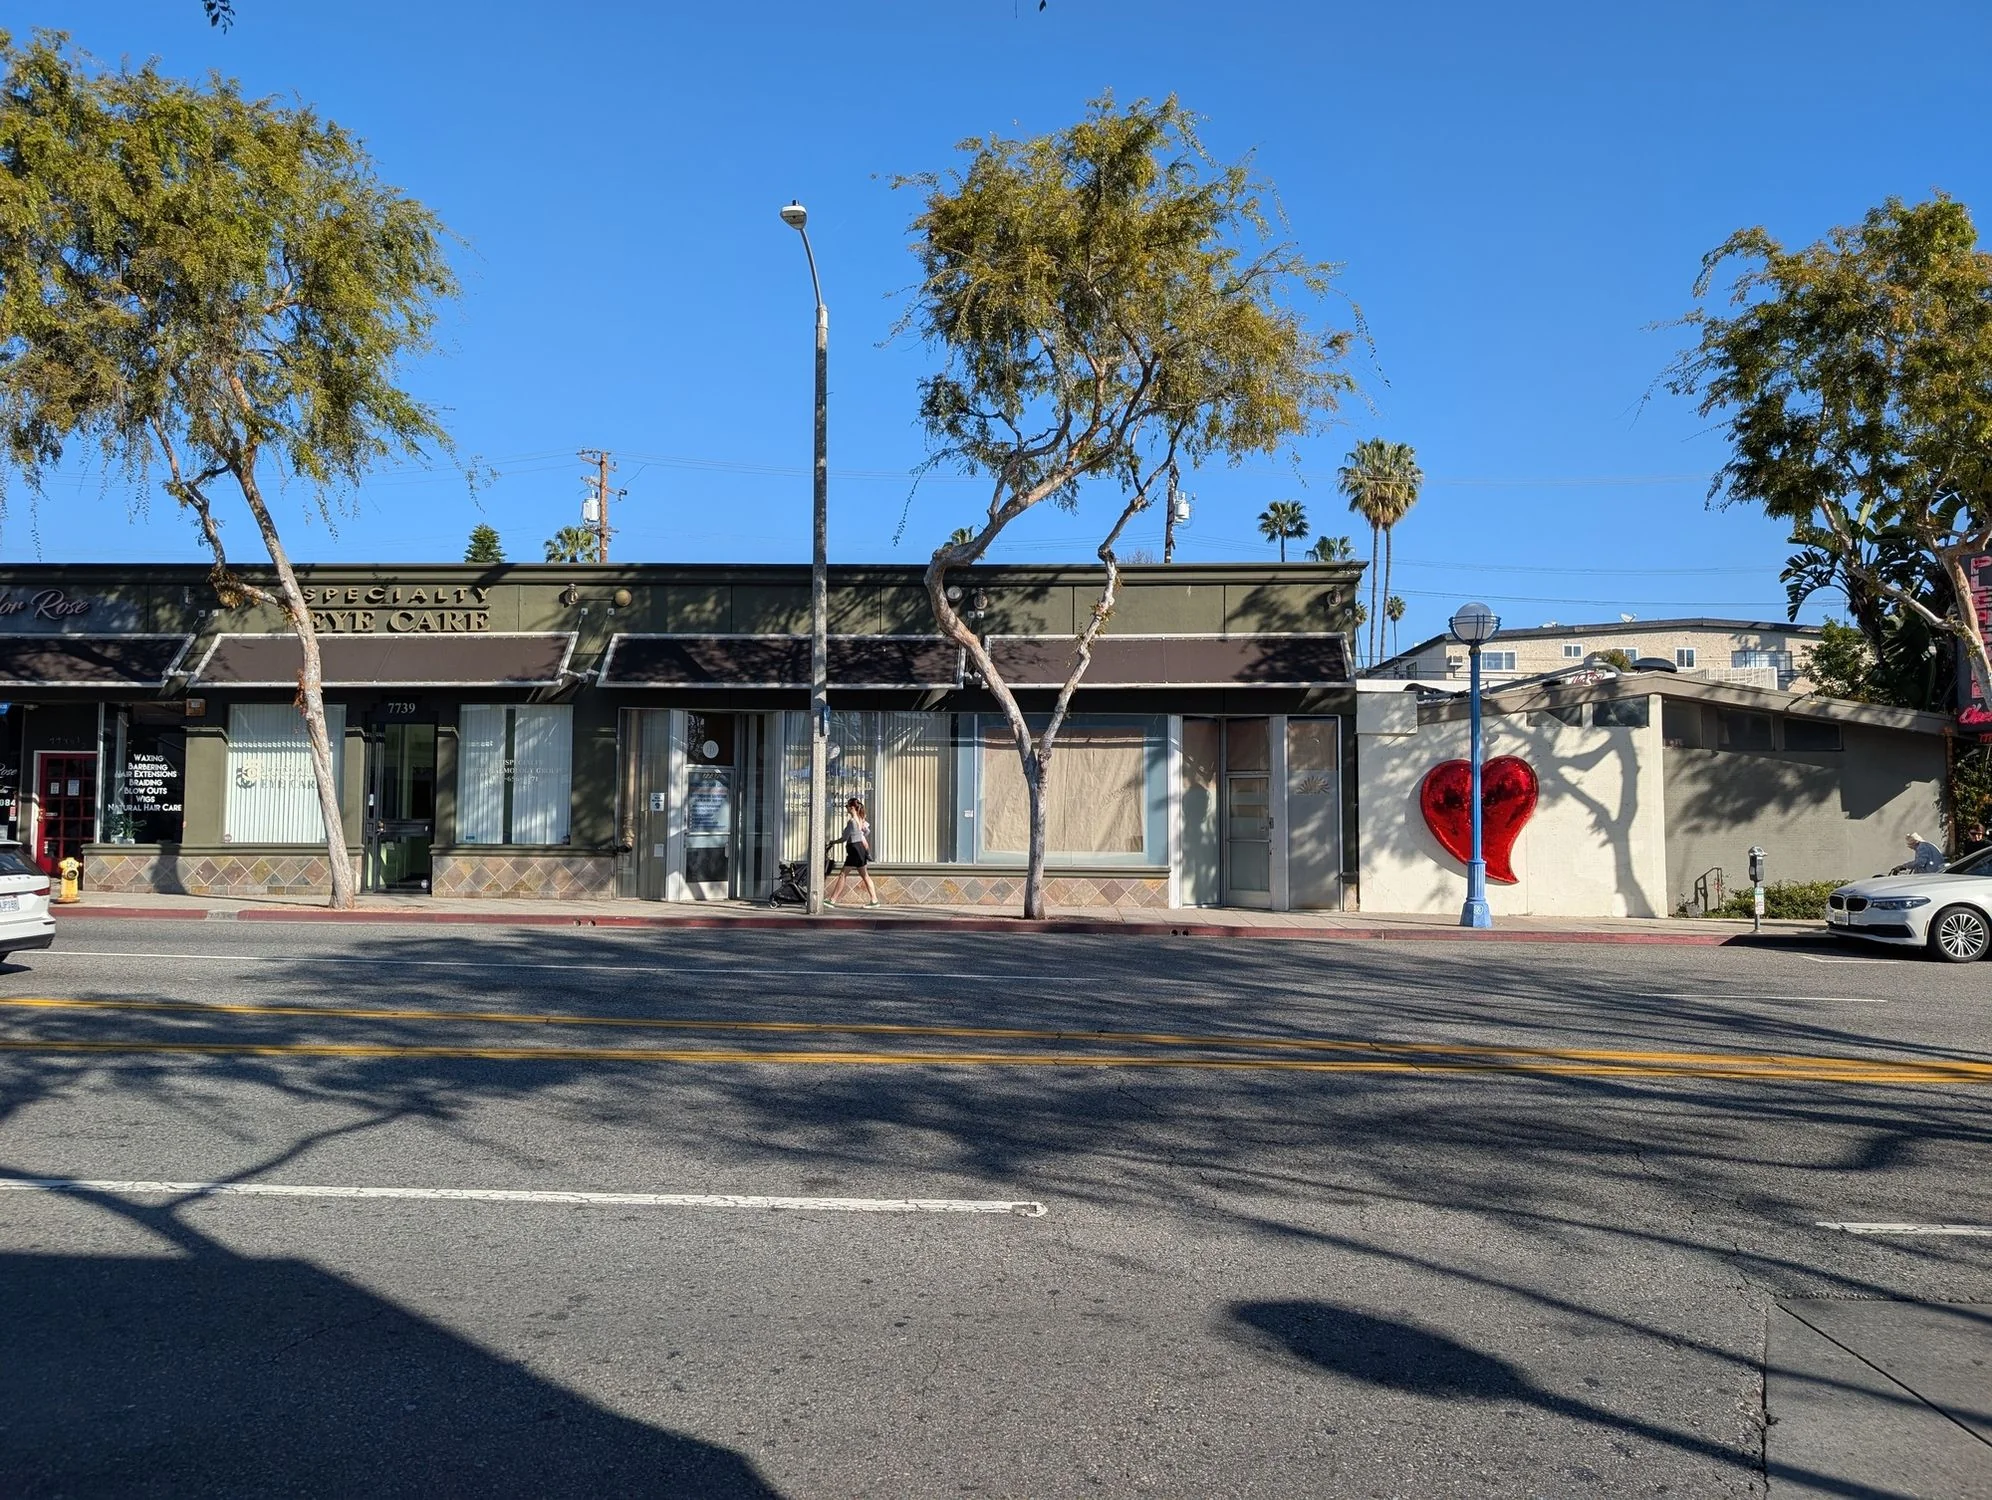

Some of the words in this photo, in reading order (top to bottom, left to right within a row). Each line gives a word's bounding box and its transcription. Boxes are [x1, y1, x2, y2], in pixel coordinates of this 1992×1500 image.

[303, 587, 491, 602] SPECIALTY
[30, 589, 89, 620] Rose
[313, 610, 376, 632] EYE
[388, 610, 491, 632] CARE
[388, 702, 416, 714] 7739
[133, 753, 164, 762] WAXING
[127, 762, 168, 771] BARBERING
[114, 770, 133, 778] HAIR
[134, 770, 177, 778] EXTENSIONS
[129, 778, 163, 786] BRAIDING
[124, 787, 145, 795] BLOW
[146, 787, 168, 795] OUTS
[135, 795, 156, 803] WIGS
[107, 803, 142, 812] NATURAL
[143, 803, 161, 812] HAIR
[162, 803, 183, 812] CARE
